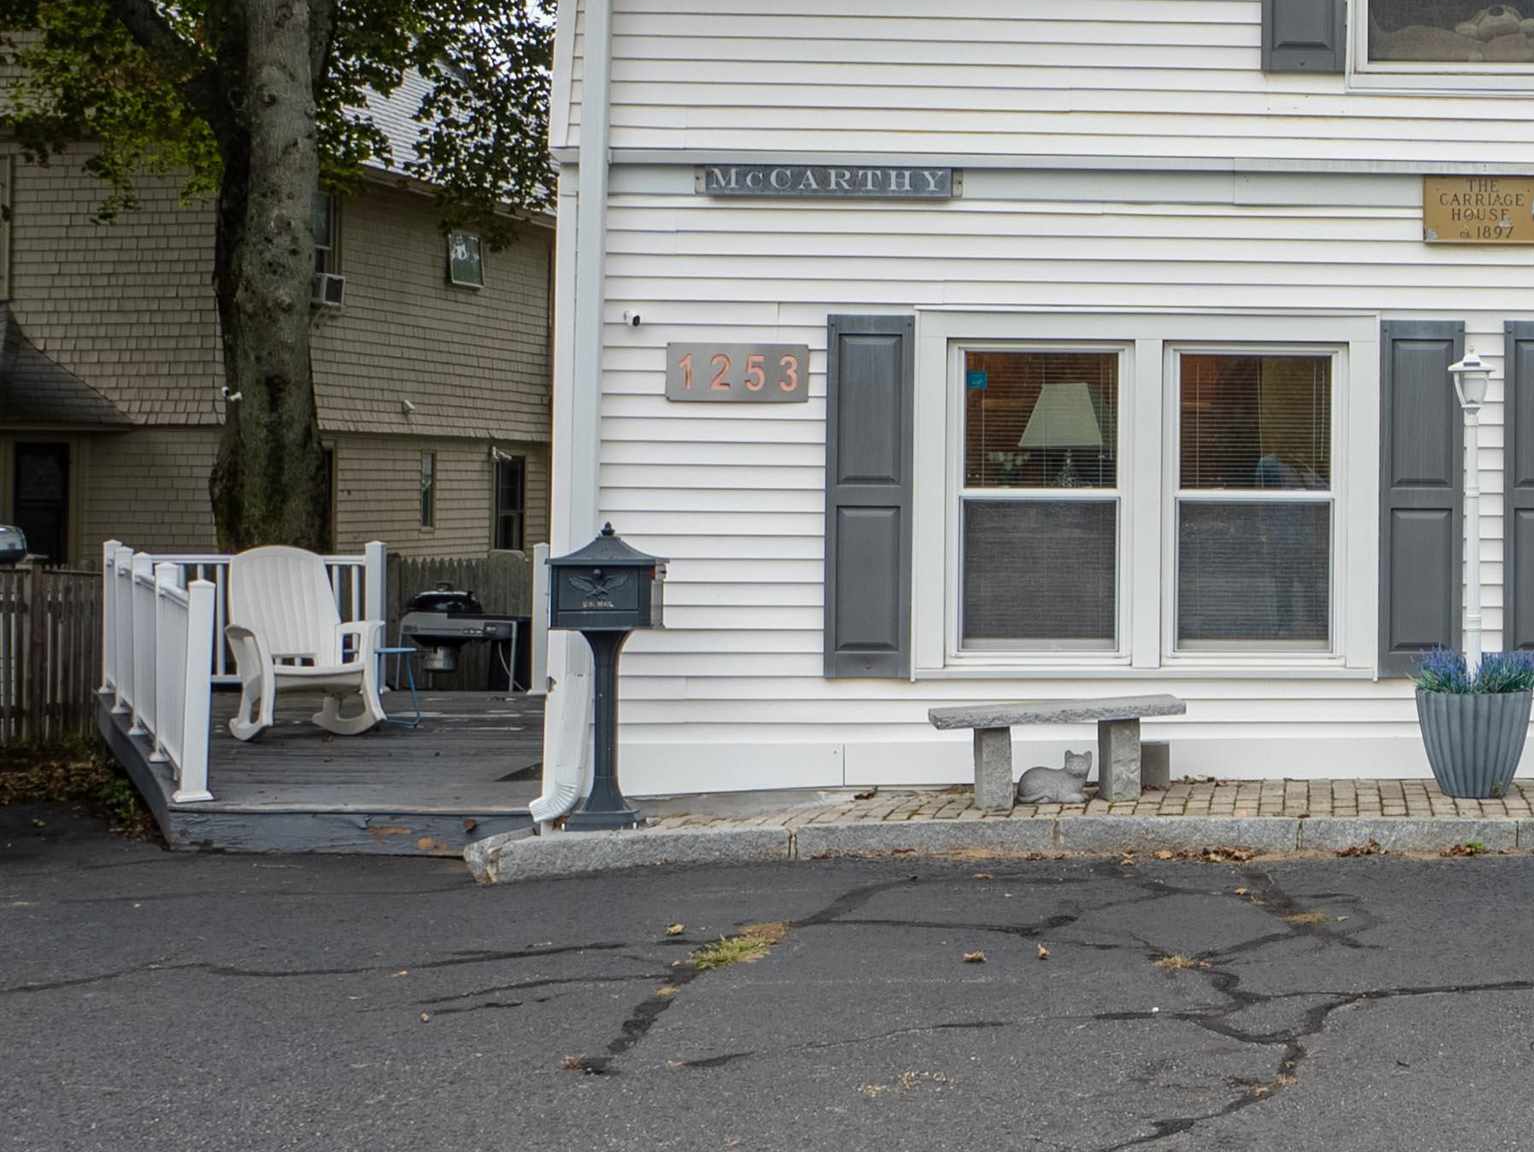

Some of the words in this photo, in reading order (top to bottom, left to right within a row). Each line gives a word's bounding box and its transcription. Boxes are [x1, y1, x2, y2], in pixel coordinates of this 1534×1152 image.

[1466, 176, 1499, 192] THE
[1439, 193, 1524, 207] CARRIAGE
[1476, 226, 1514, 239] 1897
[679, 353, 799, 392] 1253
